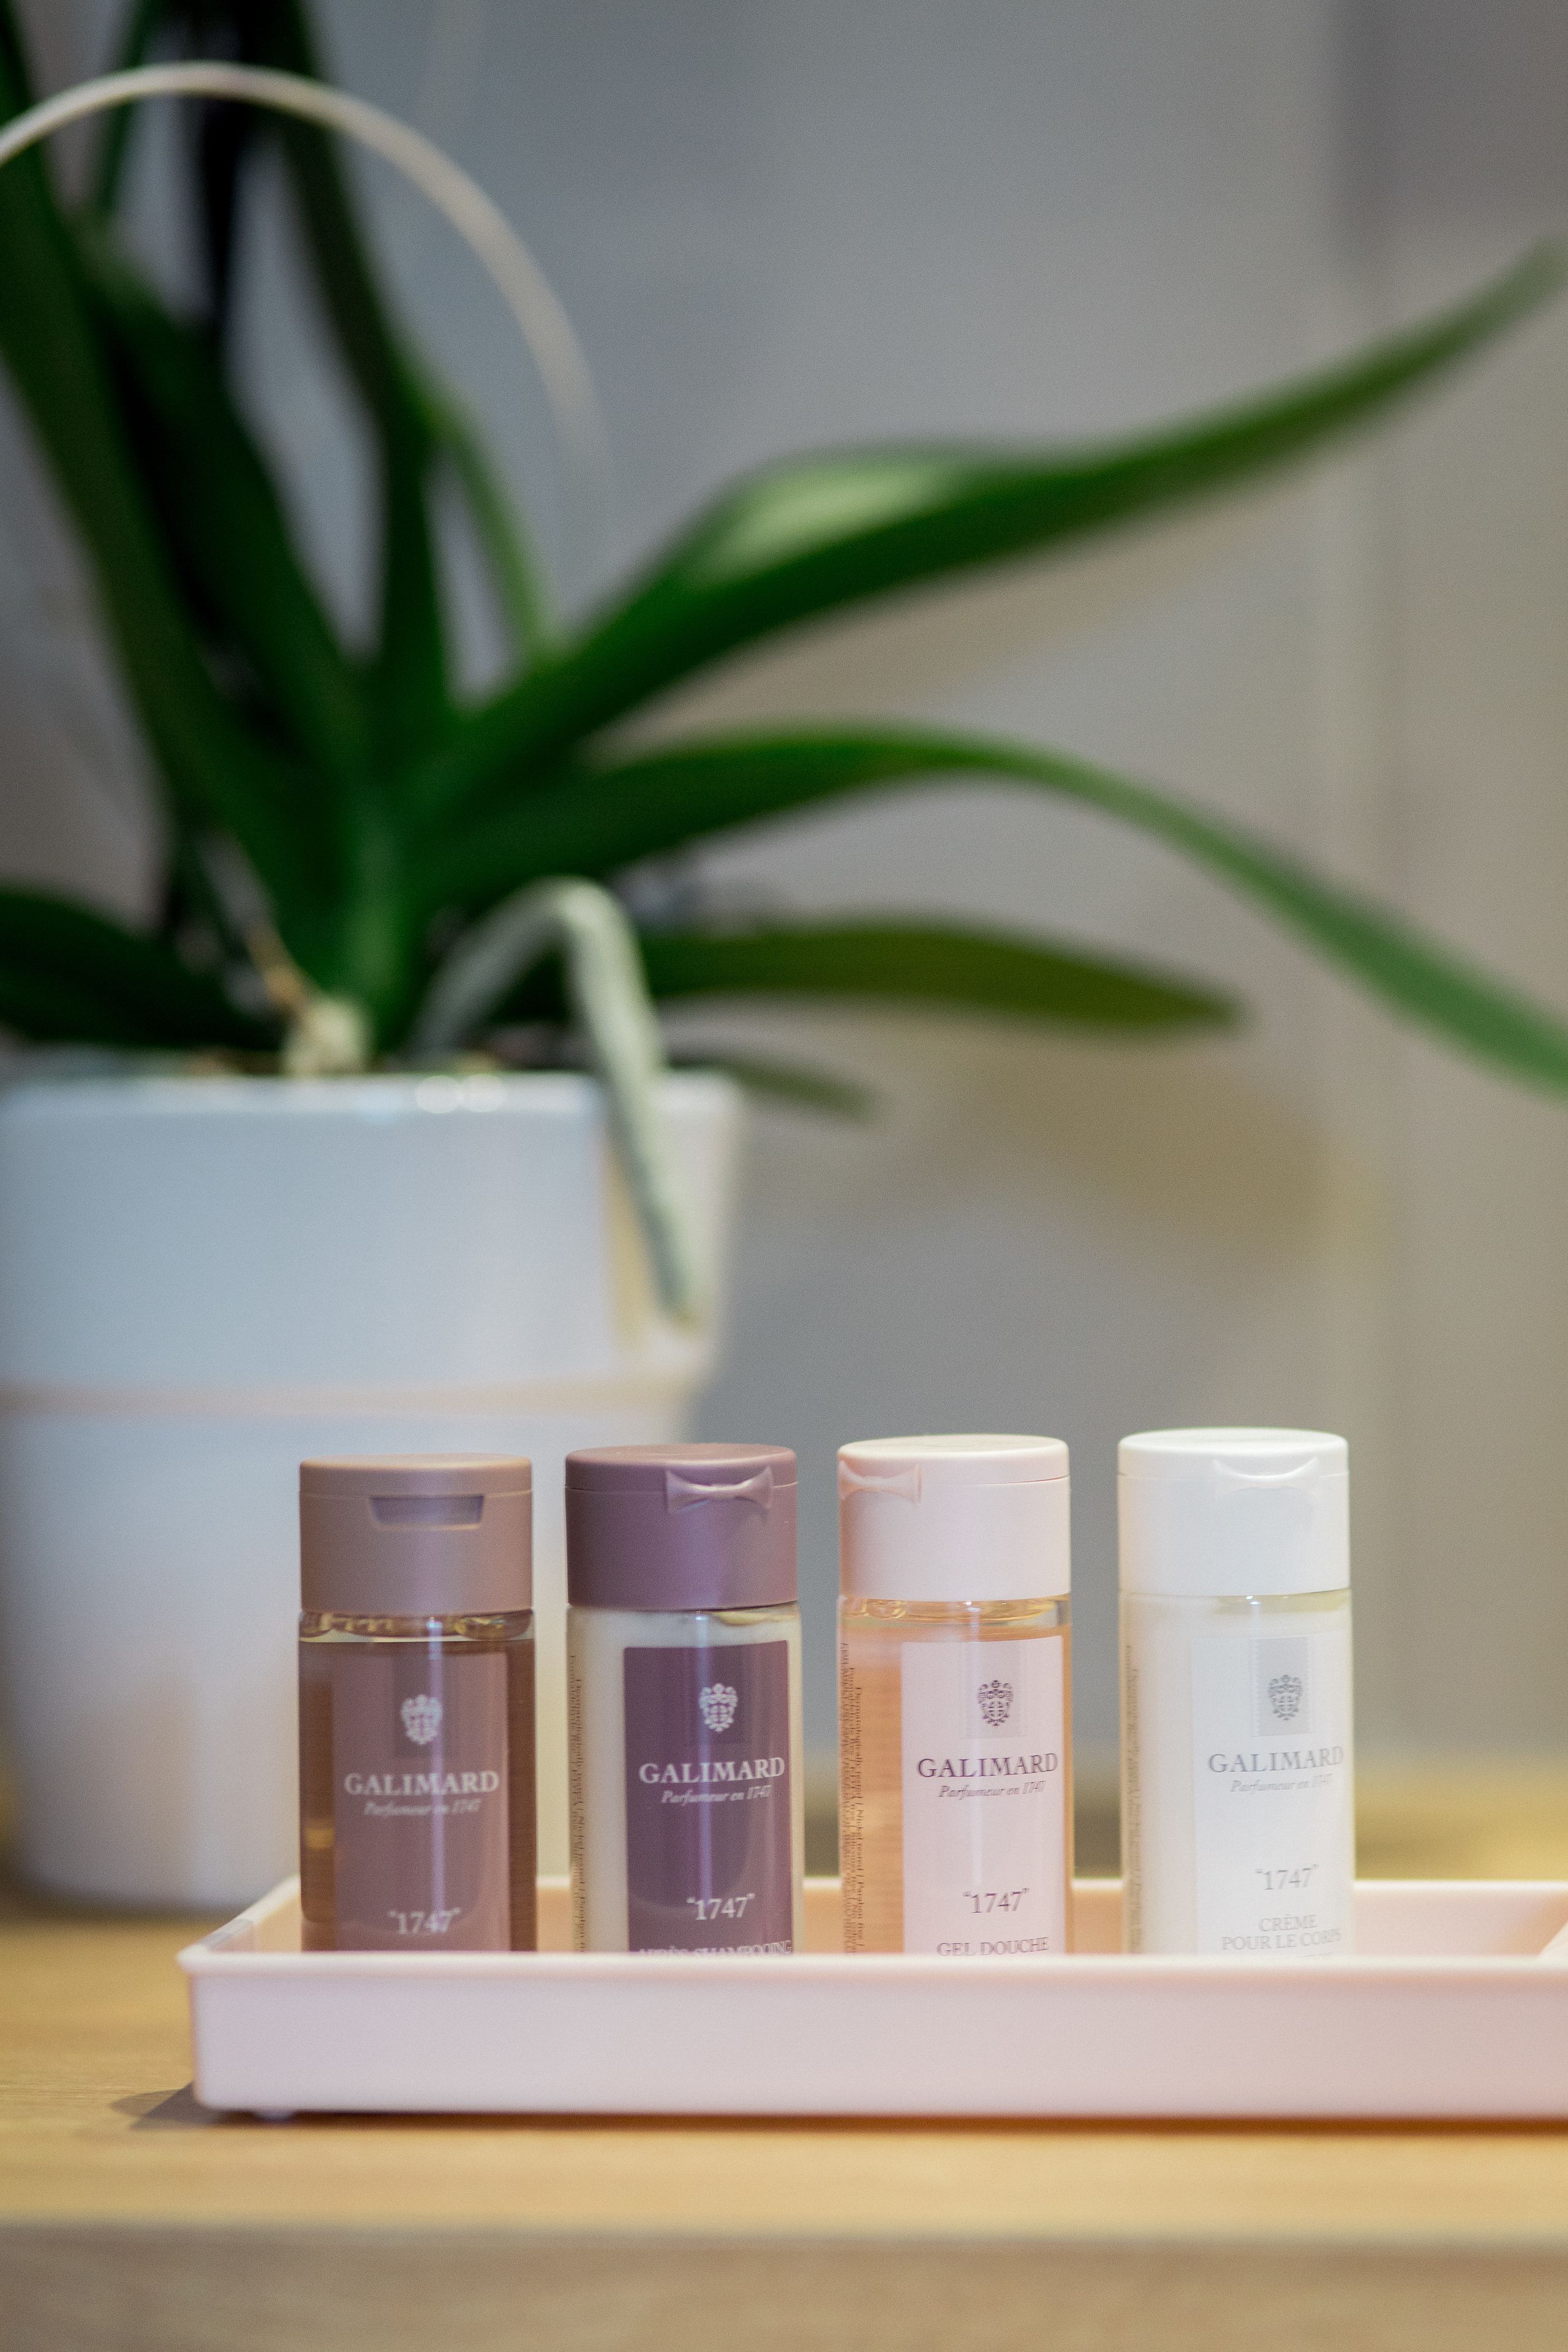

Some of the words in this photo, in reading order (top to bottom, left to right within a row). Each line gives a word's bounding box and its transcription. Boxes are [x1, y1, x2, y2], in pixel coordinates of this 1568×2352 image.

[639, 1757, 785, 1784] GALIMARD
[916, 1752, 1058, 1778] GALIMARD
[1207, 1746, 1344, 1773] GALIMARD
[344, 1770, 500, 1795] GALIMARD
[939, 1784, 1005, 1801] Parfumeur
[662, 1789, 729, 1807] Parfumeur
[937, 1942, 976, 1956] GEL
[979, 1937, 1049, 1956] DOUCHE
[1221, 1936, 1272, 1950] POUR
[1275, 1934, 1297, 1948] LE
